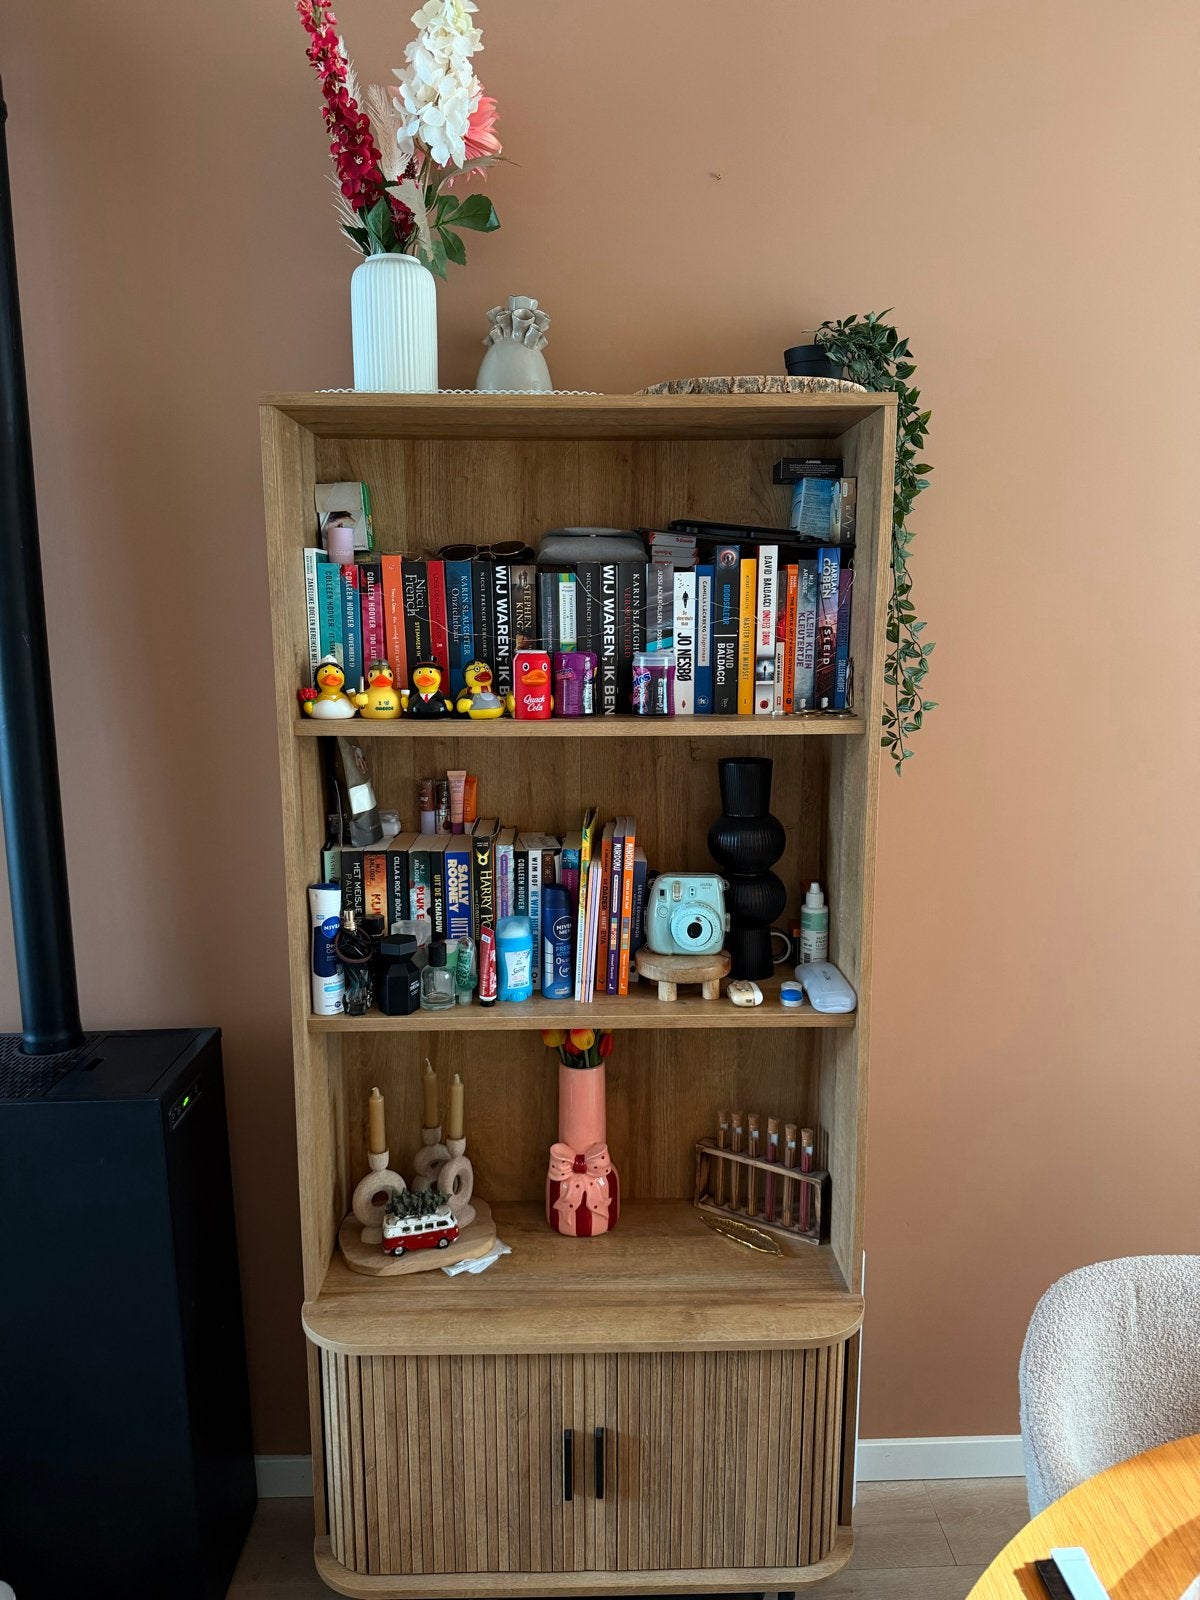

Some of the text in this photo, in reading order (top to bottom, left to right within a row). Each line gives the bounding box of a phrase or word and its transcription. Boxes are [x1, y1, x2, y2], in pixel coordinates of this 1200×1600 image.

[307, 578, 316, 605] ZAKELIJKE
[325, 571, 333, 600] COLLEEN
[345, 571, 353, 600] COLLEEN
[367, 571, 375, 600] COLLEEN
[495, 565, 507, 594] WIJ
[822, 557, 831, 599] COBEN
[405, 574, 419, 617] French
[415, 579, 427, 609] Nicci
[524, 584, 532, 628] STEPHEN
[761, 555, 772, 646] DAVID BALDACCI ONDER DRUK
[326, 602, 335, 627] HOOVER
[451, 588, 461, 643] Onzichtbaar
[516, 602, 524, 630] KING
[310, 627, 318, 652] BEREIKEN
[462, 604, 471, 656] SLAUGHTER
[496, 599, 509, 661] WAREN,
[603, 565, 616, 715] WIJ WAREN, IK BEN
[633, 609, 641, 653] SLAUGH
[656, 629, 664, 649] DOSSIE
[796, 612, 806, 668] KLEUTERTJE
[804, 610, 814, 669] KLEIN KLEIN
[348, 633, 356, 662] NOVEMBER
[676, 632, 693, 682] JO NESBØ
[726, 642, 735, 669] DAVID
[499, 666, 510, 681] IK
[717, 643, 726, 685] BALDACCI
[838, 659, 846, 676] COLLEEN
[523, 694, 546, 704] Quack
[527, 703, 543, 712] Cola
[353, 863, 362, 879] HET
[393, 856, 401, 874] CILLA
[345, 874, 354, 907] PAULA
[354, 881, 363, 914] MEISJE
[394, 880, 402, 899] ROLF
[416, 885, 425, 911] PLUK
[447, 859, 459, 913] ROONEY
[457, 864, 469, 906] SALLY
[480, 870, 492, 911] HARRY
[517, 858, 525, 910] COLLEEN HOOVER
[434, 874, 443, 933] UIT DE SCHADUW
[530, 898, 539, 916] WIM
[531, 917, 540, 933] HOF
[634, 905, 642, 938] EDINBURGH
[555, 944, 572, 952] FRES
